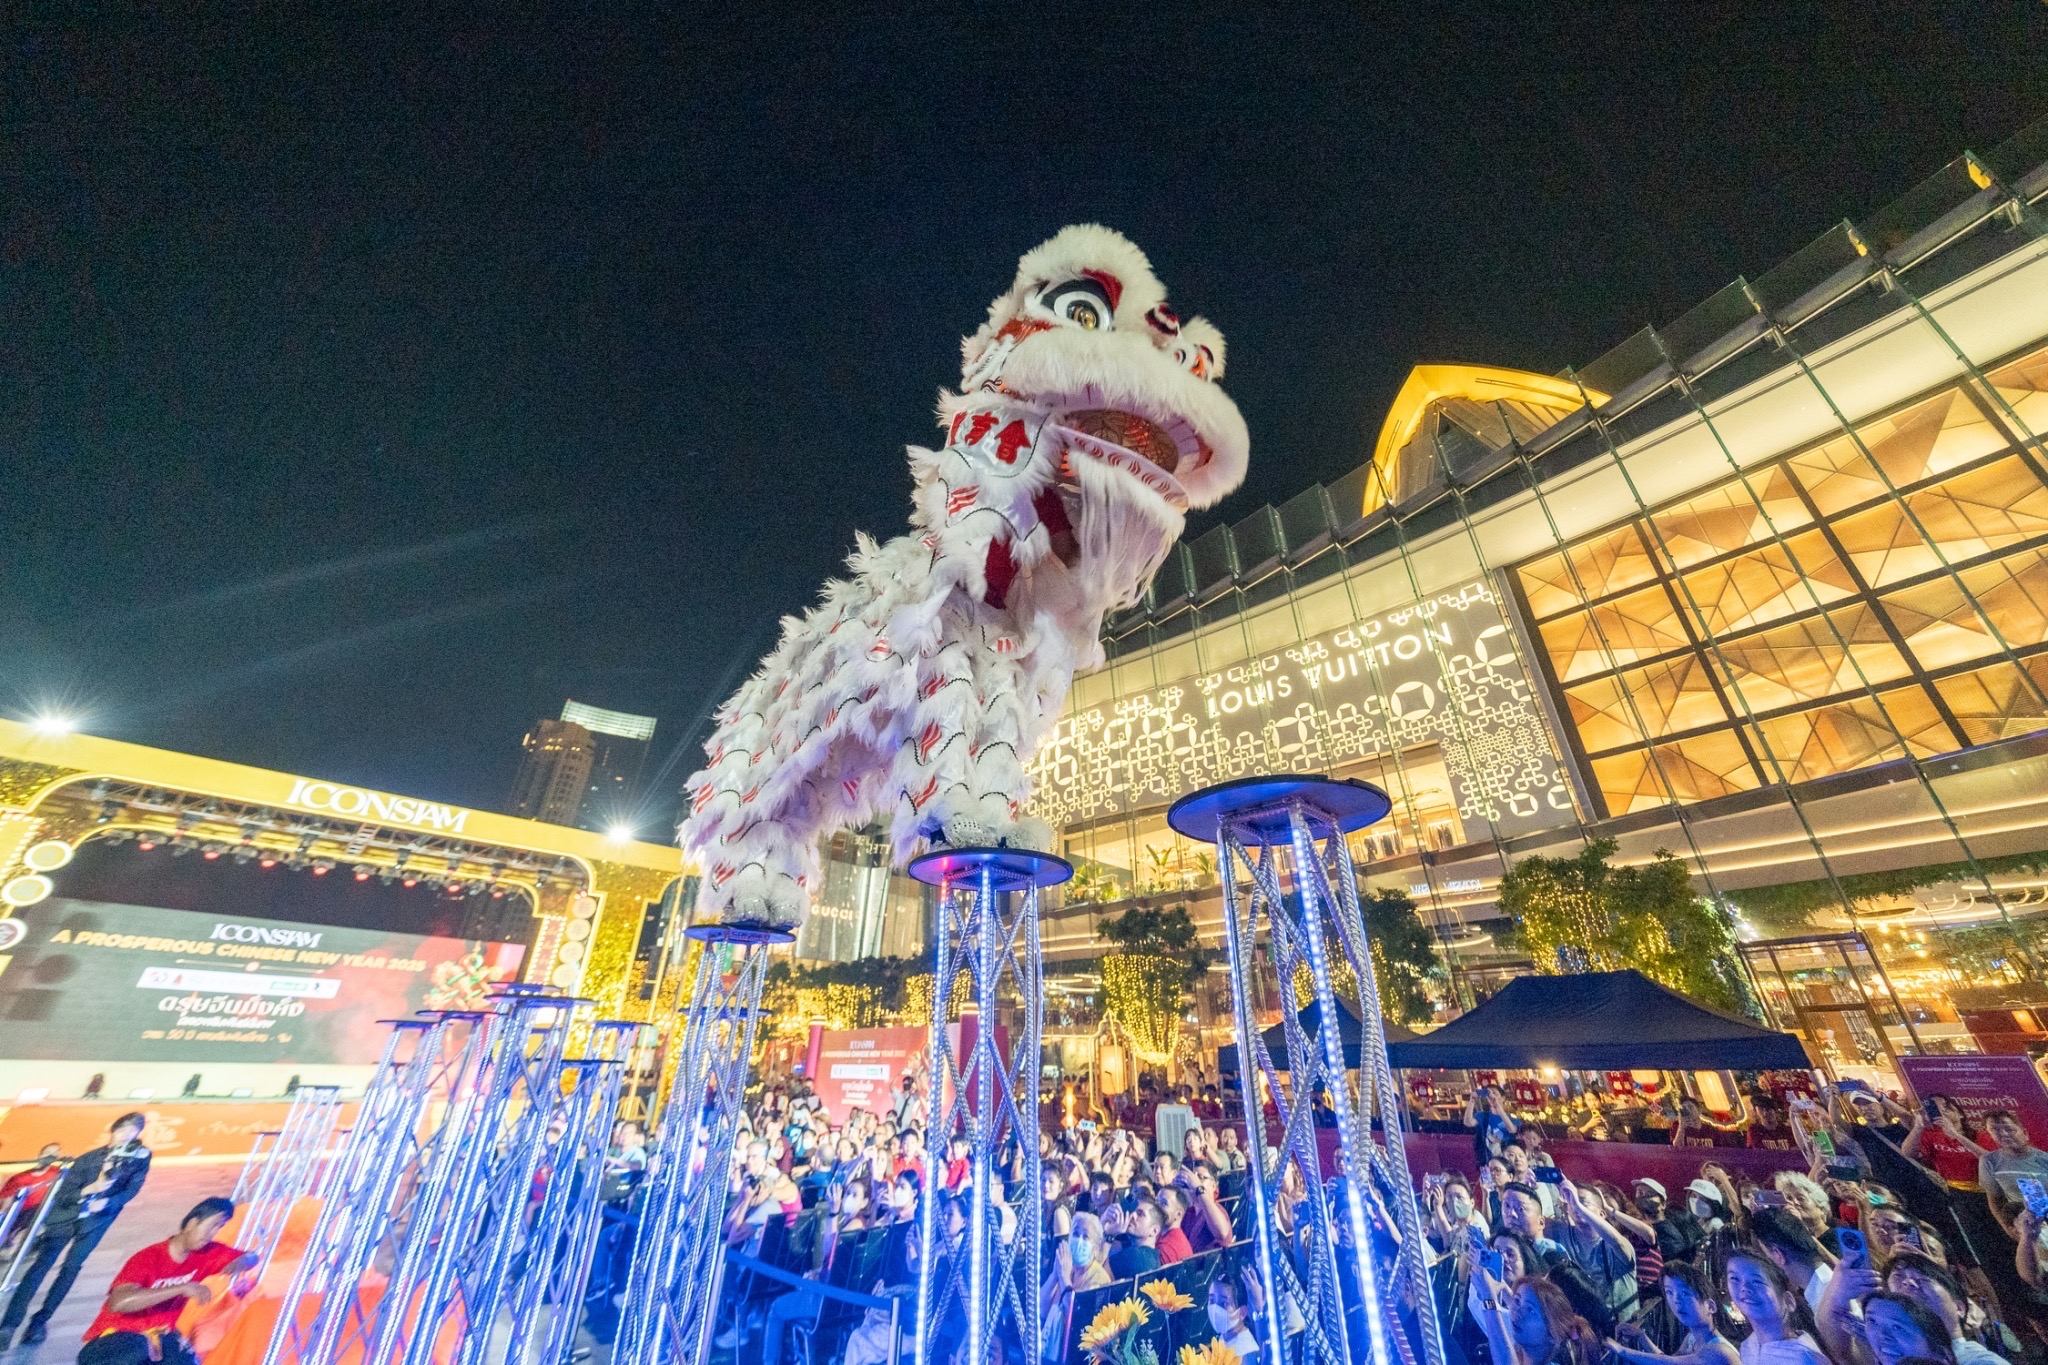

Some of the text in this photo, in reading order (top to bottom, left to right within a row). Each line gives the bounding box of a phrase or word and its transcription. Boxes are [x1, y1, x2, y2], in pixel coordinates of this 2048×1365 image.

[1207, 622, 1453, 719] LOUIS VUITTON
[285, 779, 470, 833] ICONSIAM
[811, 903, 853, 921] GUCCI
[50, 929, 427, 972] A PROSPEROUS CHINESE NEW YEAR 2025
[210, 923, 323, 948] ICONSIAM
